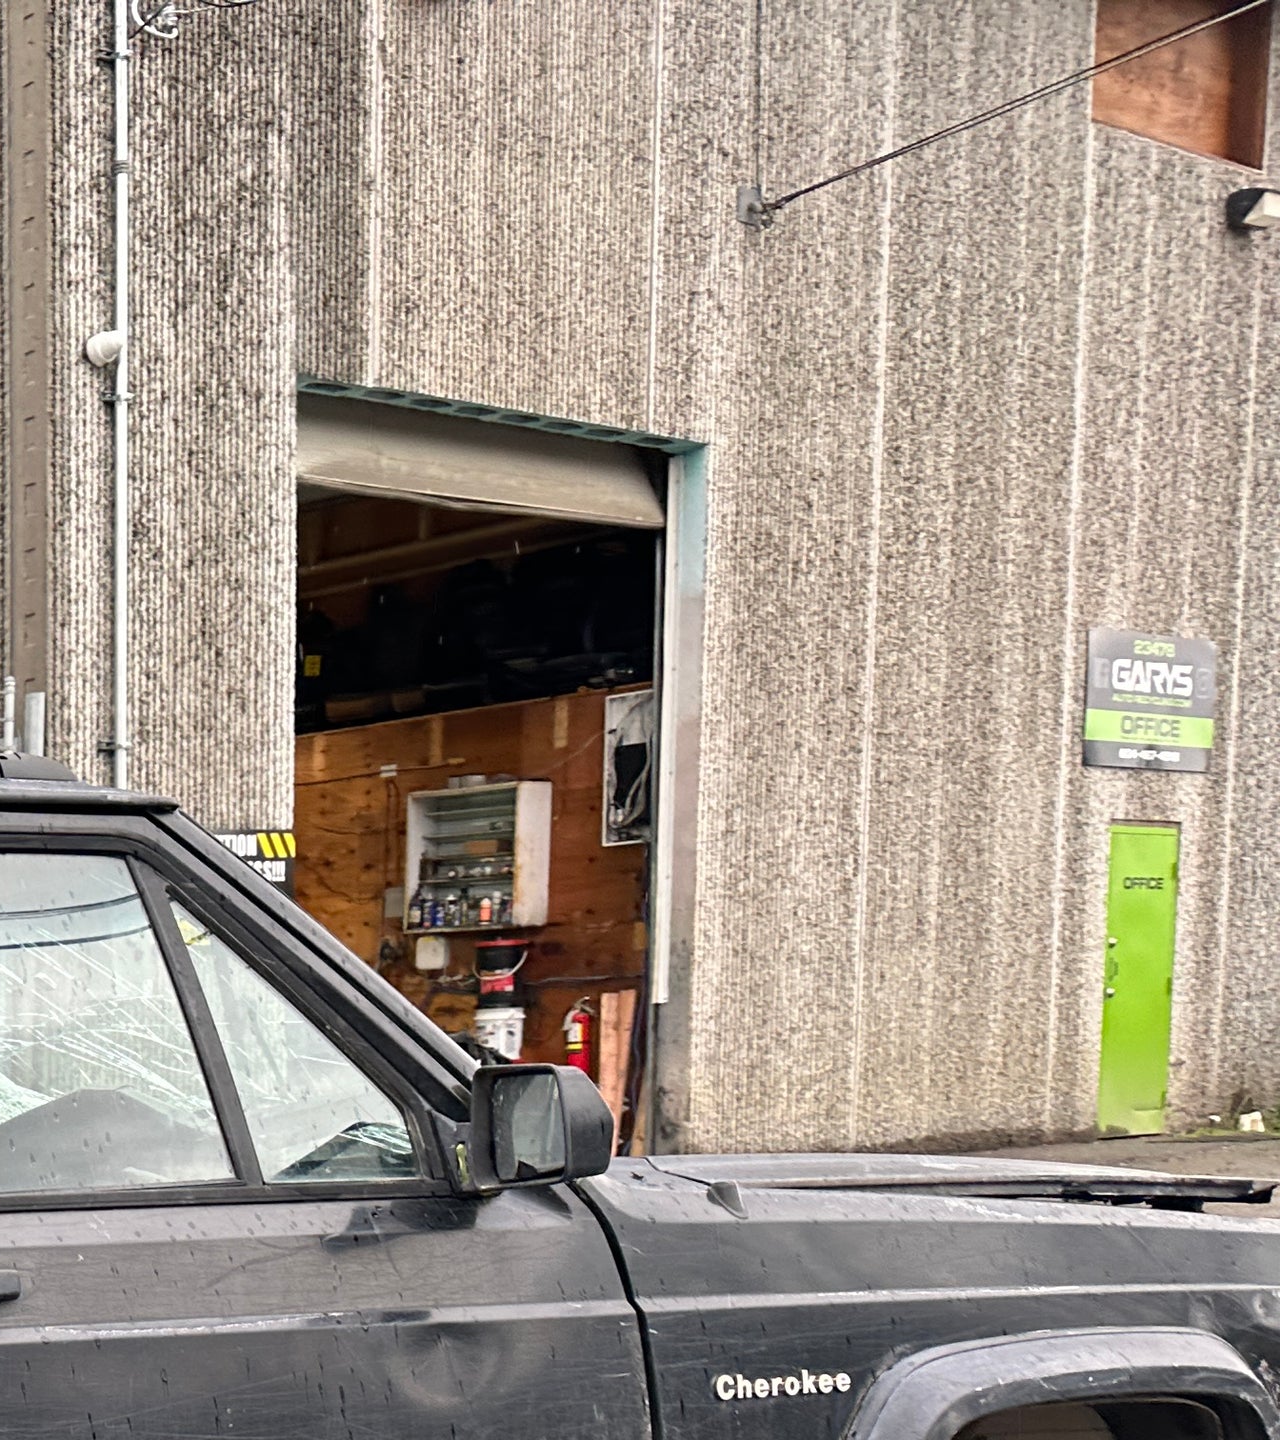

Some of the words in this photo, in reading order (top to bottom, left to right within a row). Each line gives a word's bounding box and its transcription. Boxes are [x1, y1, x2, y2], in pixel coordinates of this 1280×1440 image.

[1111, 658, 1194, 697] GARYS
[1121, 715, 1181, 738] OFFICE
[1123, 876, 1164, 890] OFFICE
[716, 1369, 852, 1401] Cherokee
